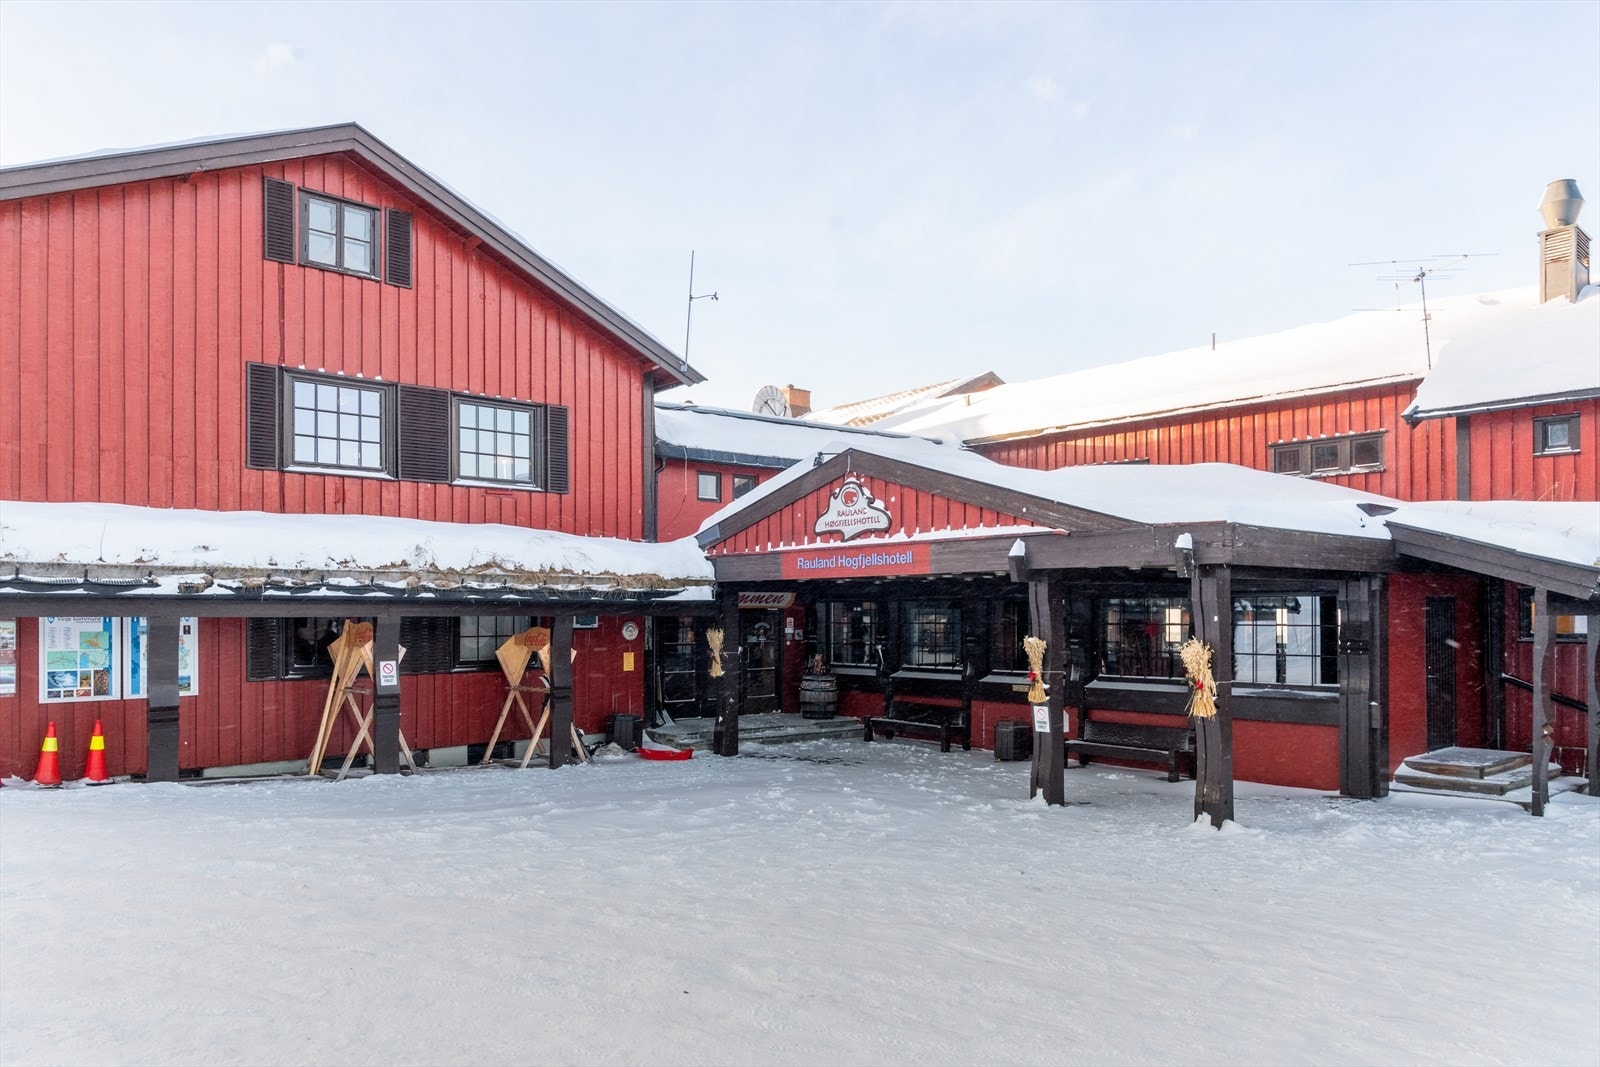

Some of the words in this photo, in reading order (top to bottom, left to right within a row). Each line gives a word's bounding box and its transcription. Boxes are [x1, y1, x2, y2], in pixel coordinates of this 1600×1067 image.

[824, 516, 881, 528] HØGFJELLSHOTELL
[797, 556, 836, 569] Rauland
[838, 551, 913, 569] Høgfjellshotell
